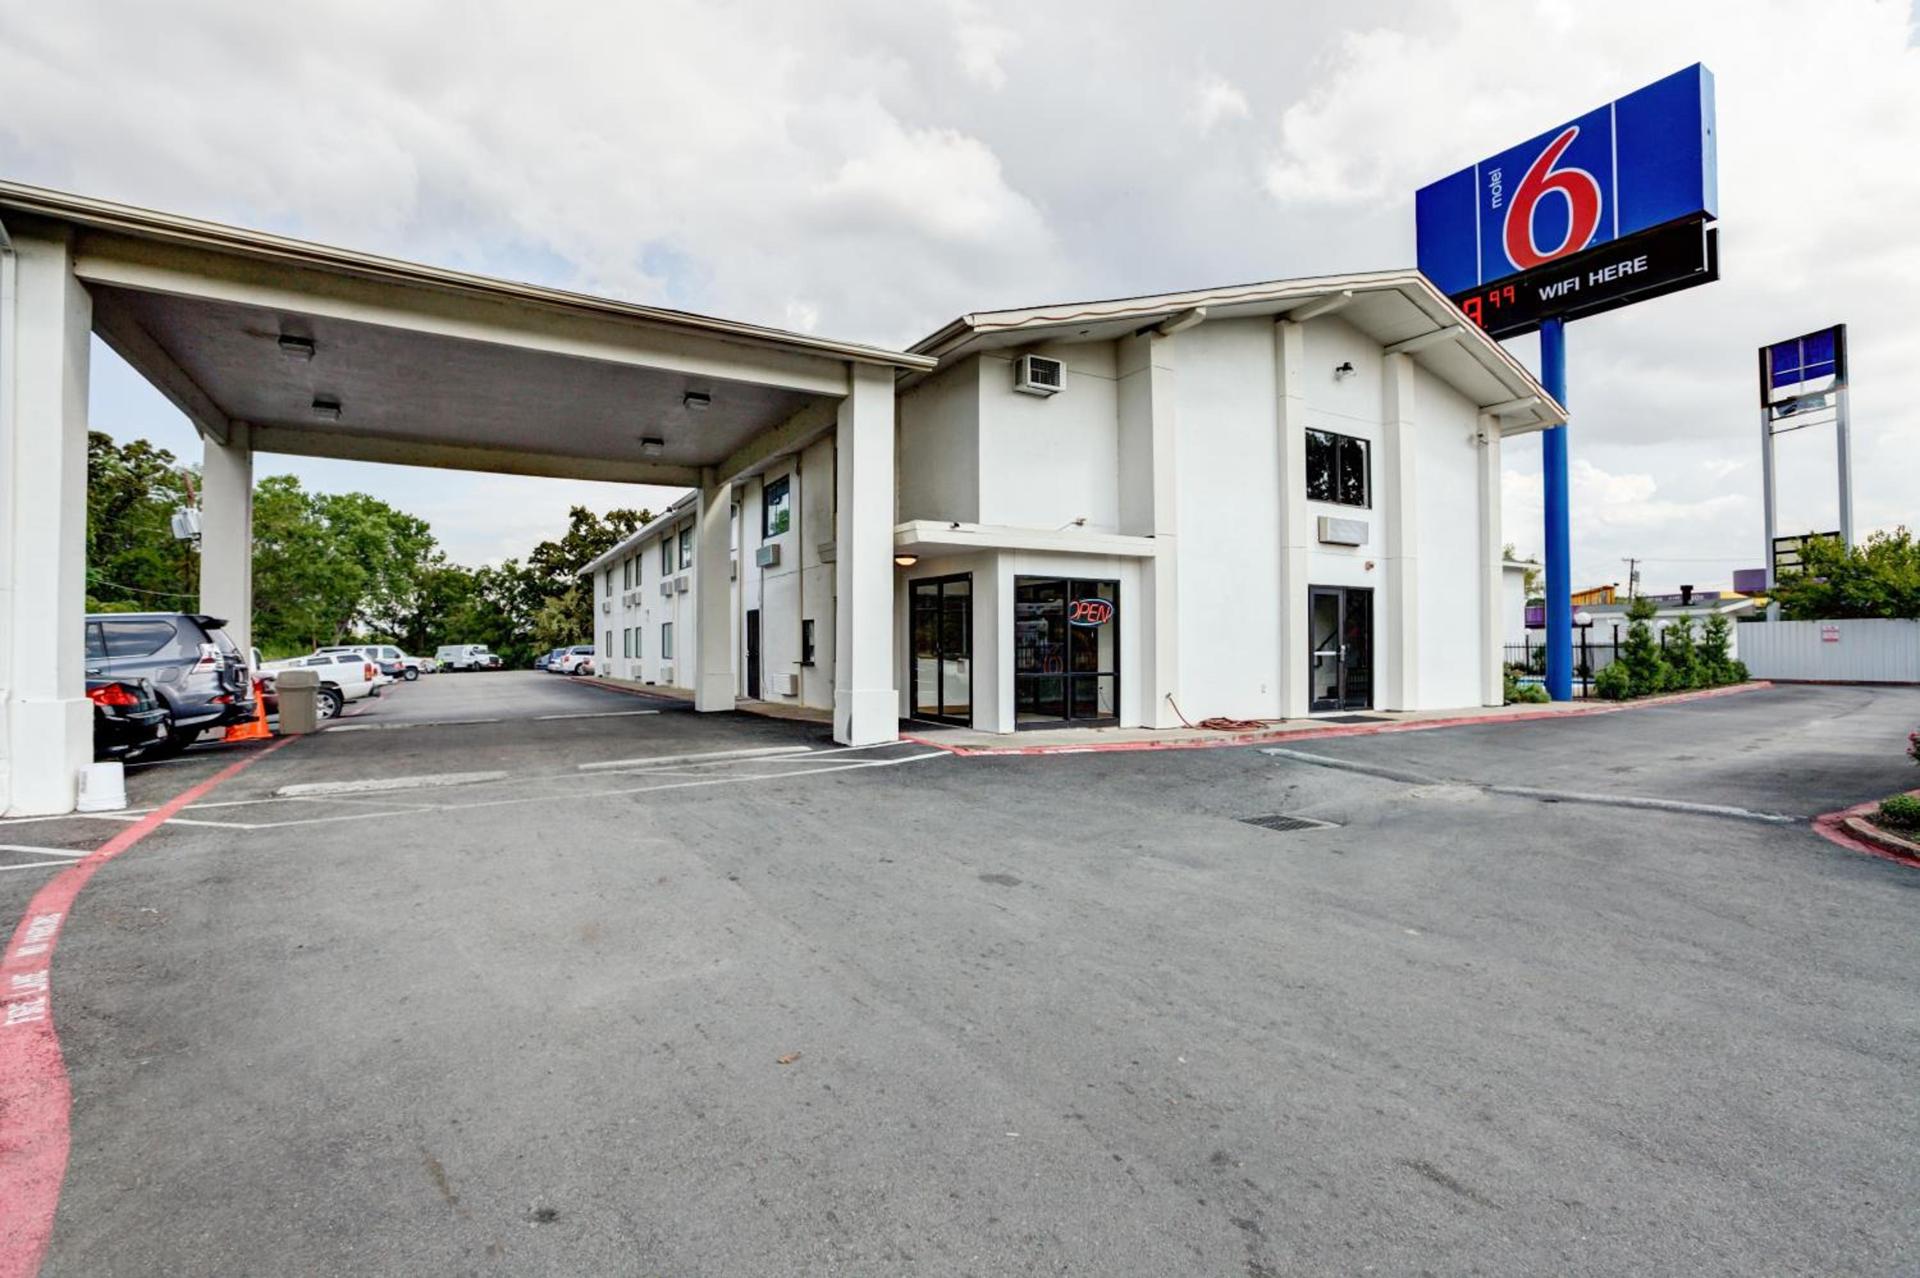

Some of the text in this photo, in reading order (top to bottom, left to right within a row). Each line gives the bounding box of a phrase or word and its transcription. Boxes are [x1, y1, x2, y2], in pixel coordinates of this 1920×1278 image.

[1488, 125, 1602, 270] motel 6
[1539, 255, 1648, 301] WIFI HERE
[1069, 601, 1110, 623] OPEN
